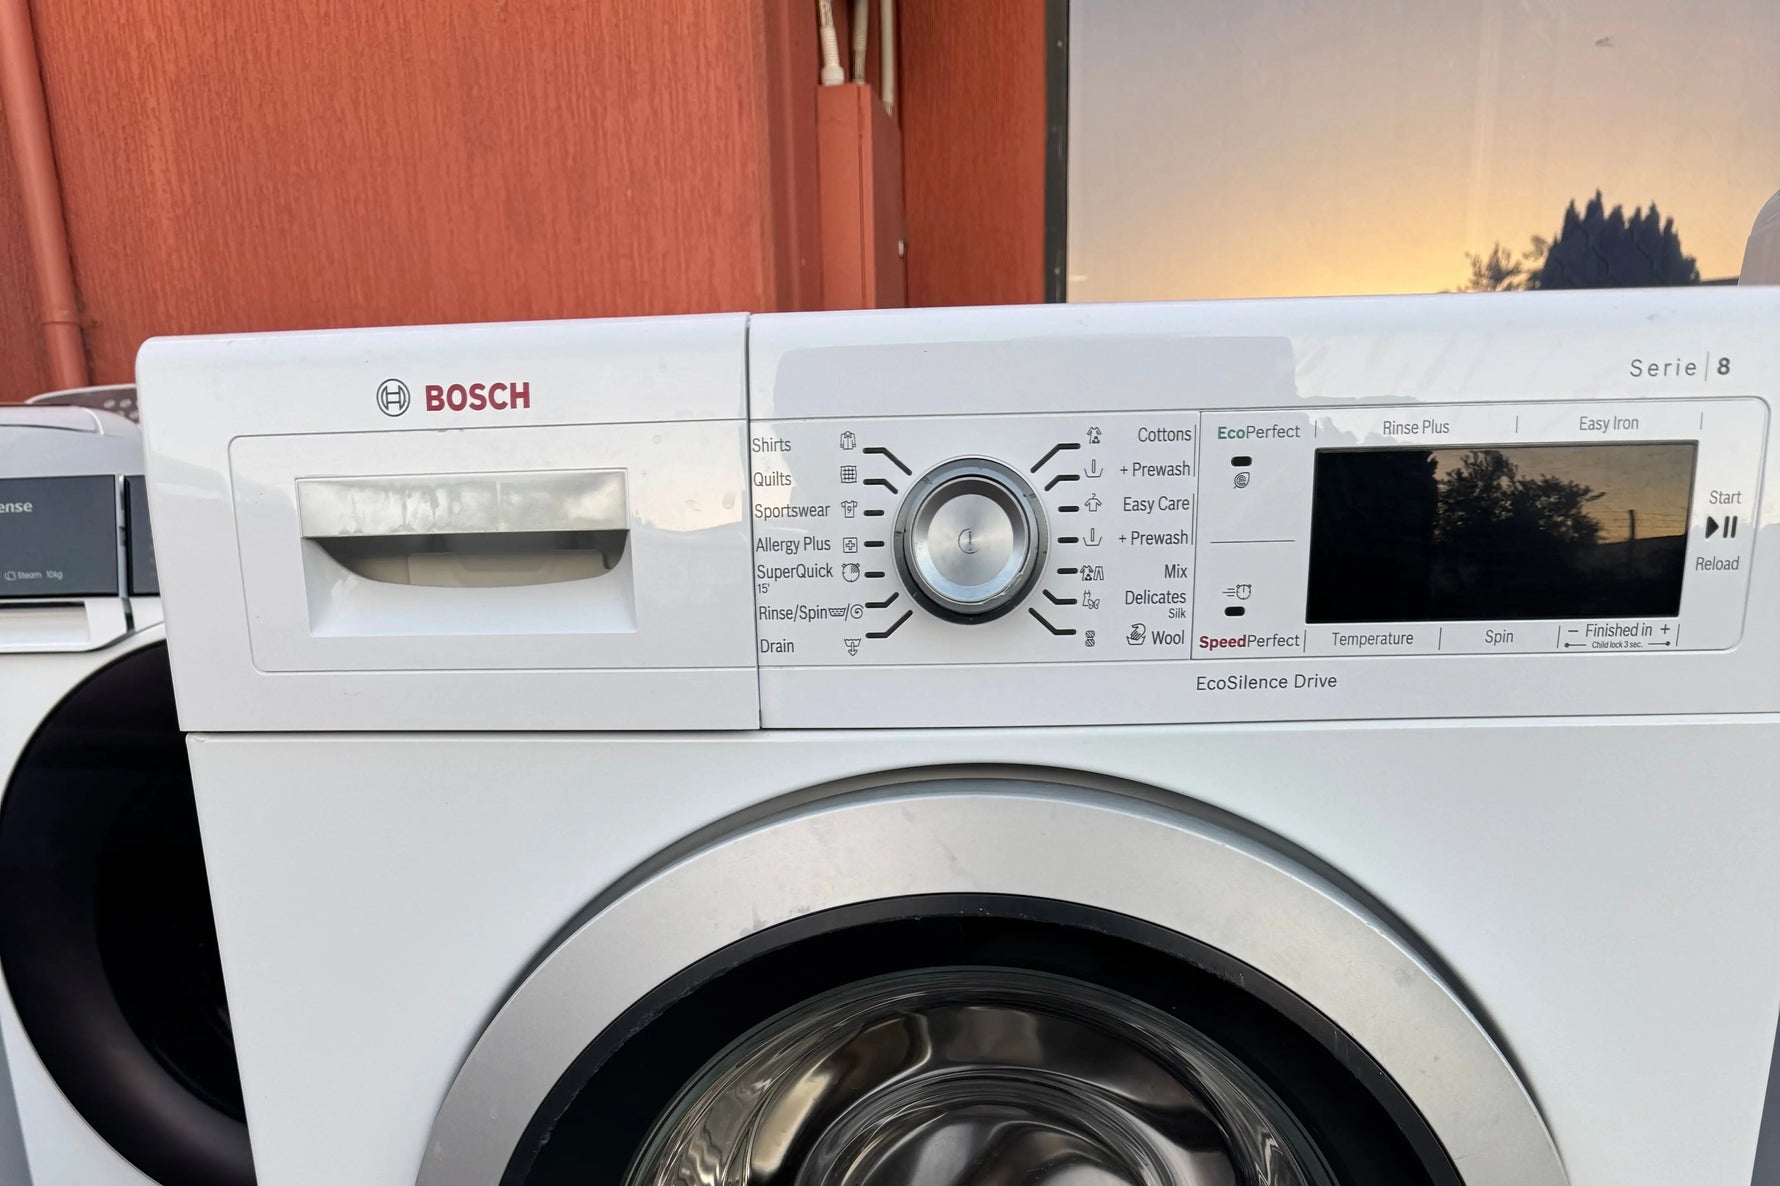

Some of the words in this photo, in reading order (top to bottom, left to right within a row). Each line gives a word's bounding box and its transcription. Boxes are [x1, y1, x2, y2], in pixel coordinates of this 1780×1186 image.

[1630, 358, 1697, 377] Serie
[1717, 357, 1731, 375] 8
[425, 382, 530, 411] BOSCH
[1217, 424, 1301, 440] EcoPerfect
[1383, 421, 1420, 435] Rinse
[1423, 420, 1450, 434] Plus
[1579, 417, 1610, 432] Easy
[1613, 416, 1639, 430] Iron
[1138, 427, 1192, 443] Cottons
[752, 437, 792, 452] Shirts
[1132, 461, 1191, 477] Prewash
[753, 472, 792, 487] Quilts
[1123, 497, 1154, 514] Easy
[1158, 496, 1190, 511] Care
[1709, 490, 1742, 505] Start
[755, 504, 831, 520] Sportswear
[756, 537, 800, 555] Allergy
[804, 536, 831, 551] Plus
[1131, 530, 1189, 546] Prewash
[1164, 564, 1188, 579] Mix
[1695, 556, 1740, 571] Reload
[757, 563, 834, 581] SuperQuick
[1125, 590, 1187, 605] Delicates
[759, 604, 828, 623] Rinse/Spin
[1168, 608, 1186, 619] Silk
[1152, 630, 1185, 645] Wool
[1485, 630, 1514, 646] Spin
[1586, 623, 1639, 638] Finished
[1641, 623, 1653, 637] in
[760, 639, 795, 653] Drain
[1199, 634, 1300, 651] SpeedPerfect
[1332, 631, 1414, 650] Temperature
[1592, 641, 1609, 649] Child
[1196, 675, 1288, 691] EcoSilence
[1294, 673, 1337, 689] Drive
